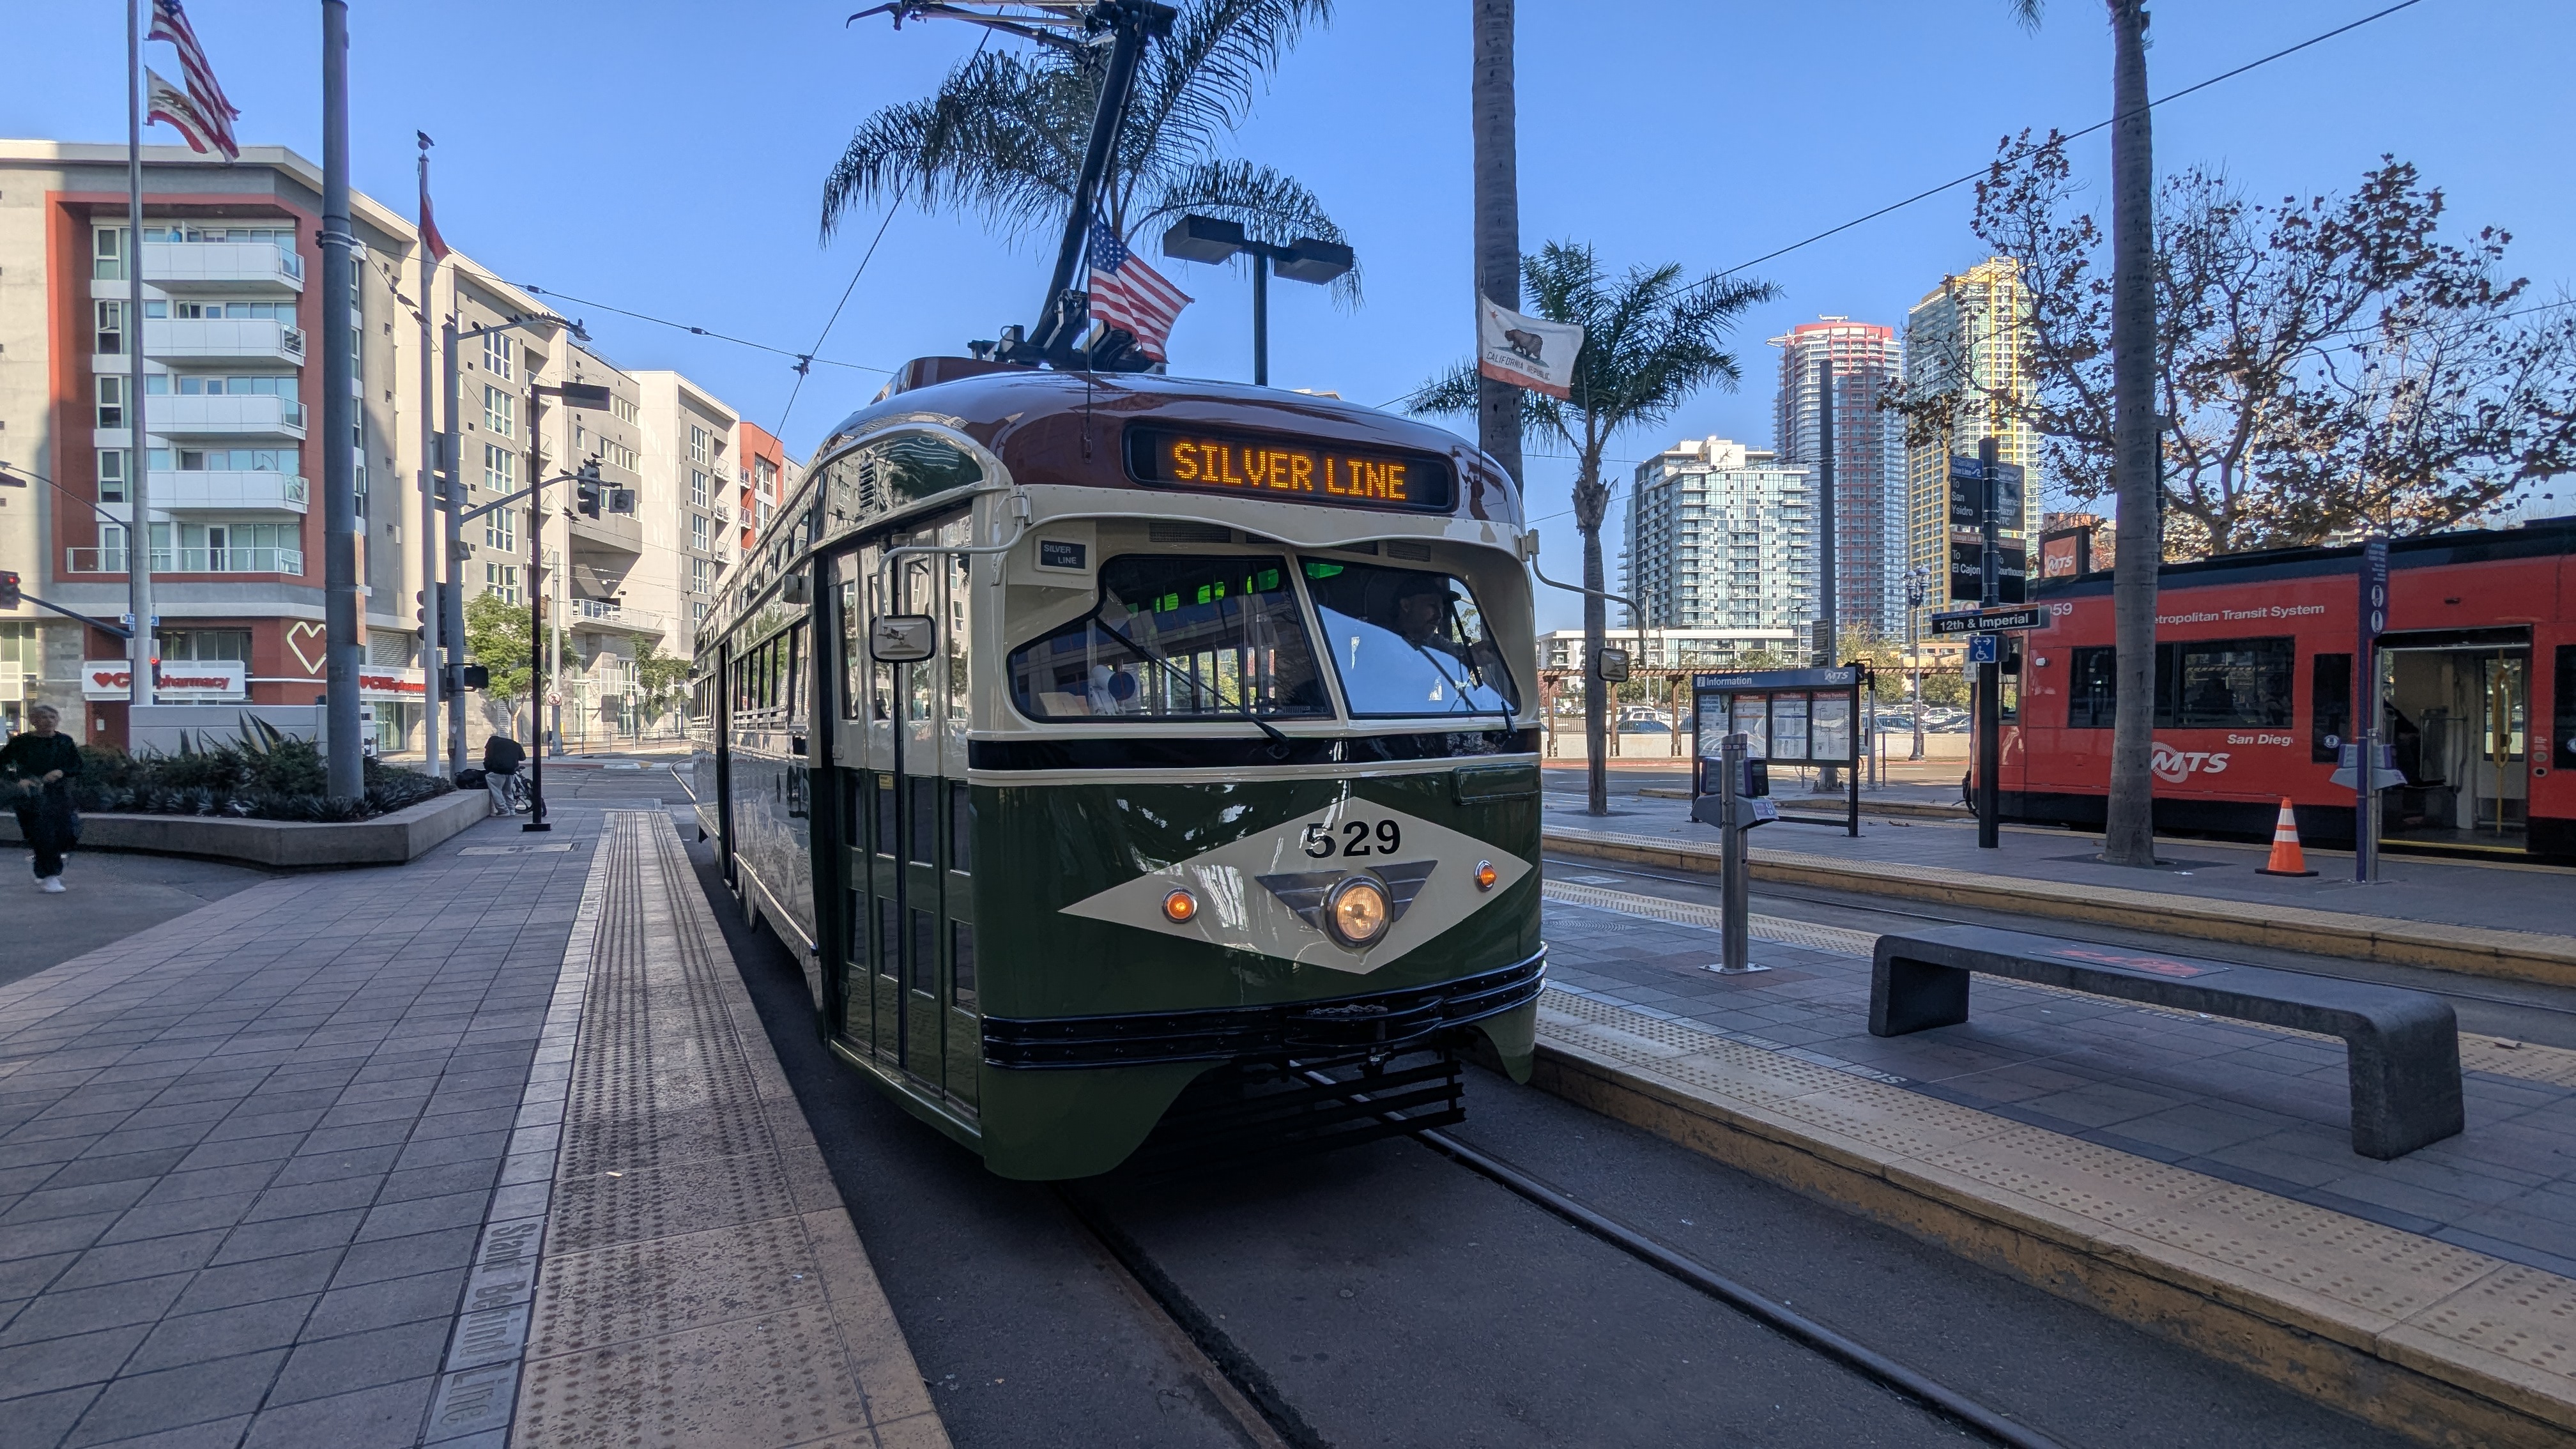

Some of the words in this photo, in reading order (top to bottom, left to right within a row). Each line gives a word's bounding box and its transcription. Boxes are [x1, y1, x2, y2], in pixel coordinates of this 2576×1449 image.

[1486, 351, 1524, 371] CALIFORNIA
[1526, 364, 1551, 381] REPUBLIC
[1174, 442, 1313, 491] SILVER
[1326, 457, 1406, 500] LINE
[1952, 478, 1960, 488] To
[1951, 491, 1965, 502] San
[1951, 504, 1974, 516] Ysidro
[1043, 544, 1071, 553] SILVER
[1952, 549, 1961, 560] To
[1057, 556, 1077, 565] LINE
[2048, 555, 2074, 571] MTS
[1952, 562, 1959, 573] El
[1960, 563, 1981, 576] Cajon
[2154, 610, 2219, 625] etropolitan
[2221, 607, 2268, 620] Transit
[2271, 604, 2325, 618] System
[1940, 620, 1965, 631] 12th
[1967, 618, 1976, 629] &
[1979, 613, 2029, 630] Imperial
[1706, 676, 1752, 687] Information
[1825, 671, 1849, 681] MTS
[2227, 734, 2254, 745] San
[2150, 752, 2231, 773] MTS
[1305, 819, 1401, 859] 529
[2136, 1009, 2195, 1022] Line
[482, 1223, 538, 1273] Stand
[459, 1280, 527, 1358] Behind
[440, 1362, 512, 1425] Line
